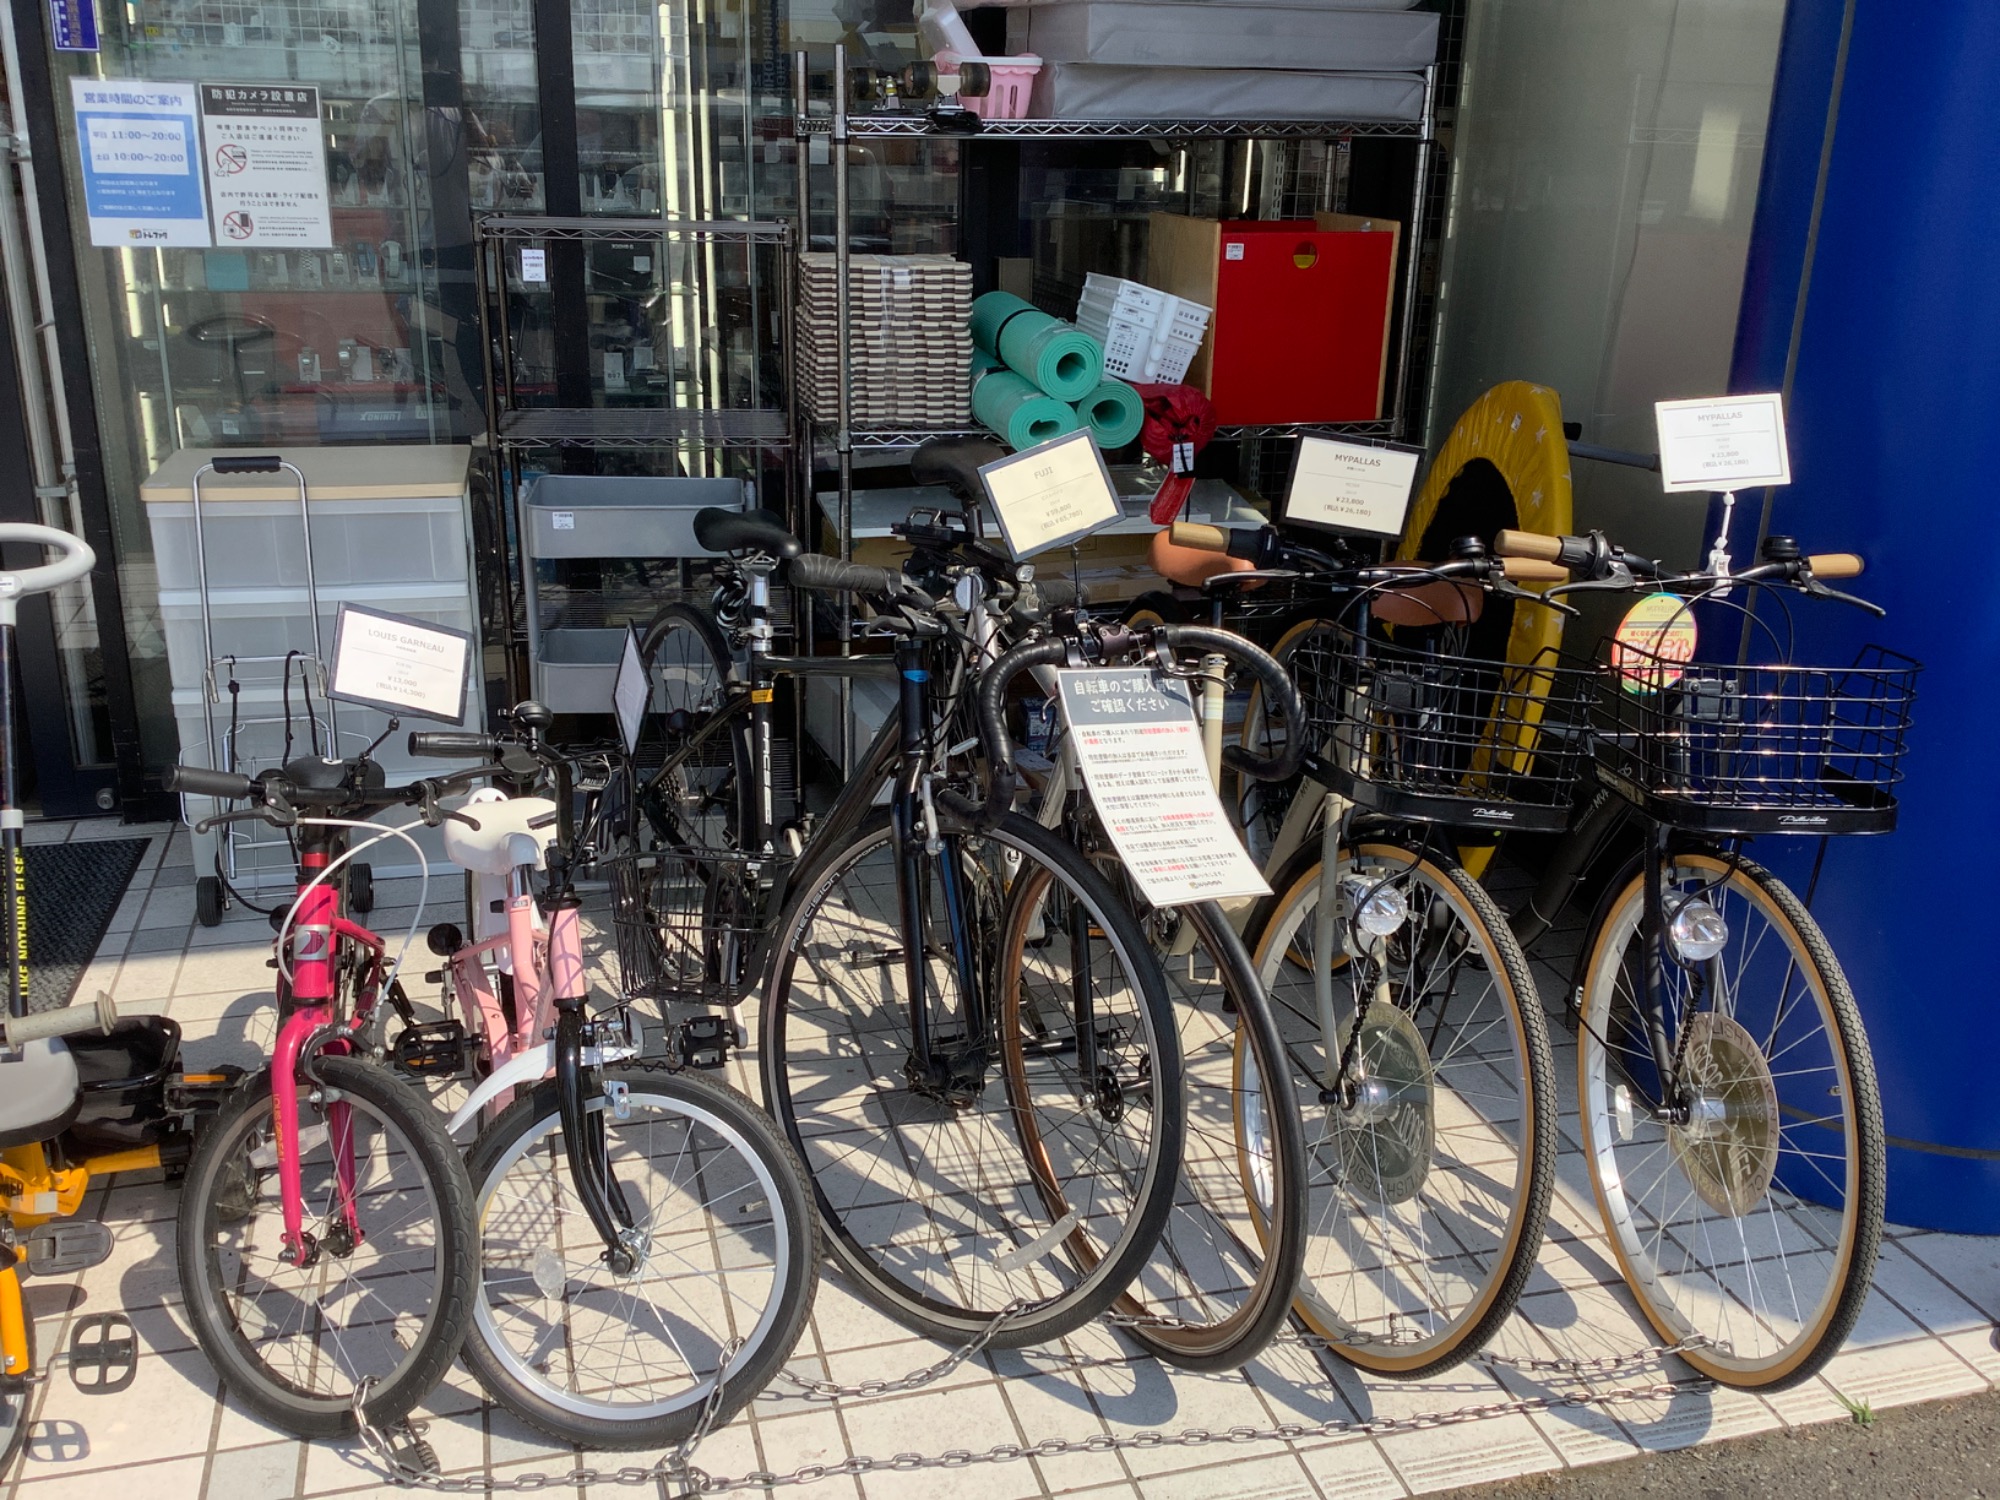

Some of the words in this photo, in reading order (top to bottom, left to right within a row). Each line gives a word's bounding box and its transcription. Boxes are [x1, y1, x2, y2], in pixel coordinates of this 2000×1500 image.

[83, 92, 183, 107] 営業時間のご案内
[211, 88, 307, 102] 防犯カメラ設置店
[1697, 411, 1743, 422] MYPALLAS
[1334, 453, 1382, 467] MYPALLAS
[1033, 466, 1054, 480] FUJI
[368, 628, 398, 642] LOUIS
[399, 635, 445, 654] GARNEAU
[1074, 677, 1177, 696] 自転車のご購入前に
[1090, 697, 1170, 714] ご確認ください
[14, 857, 26, 891] ELSE
[789, 872, 840, 953] PRECISION
[16, 895, 28, 960] NOTHING
[19, 965, 29, 996] LIKE
